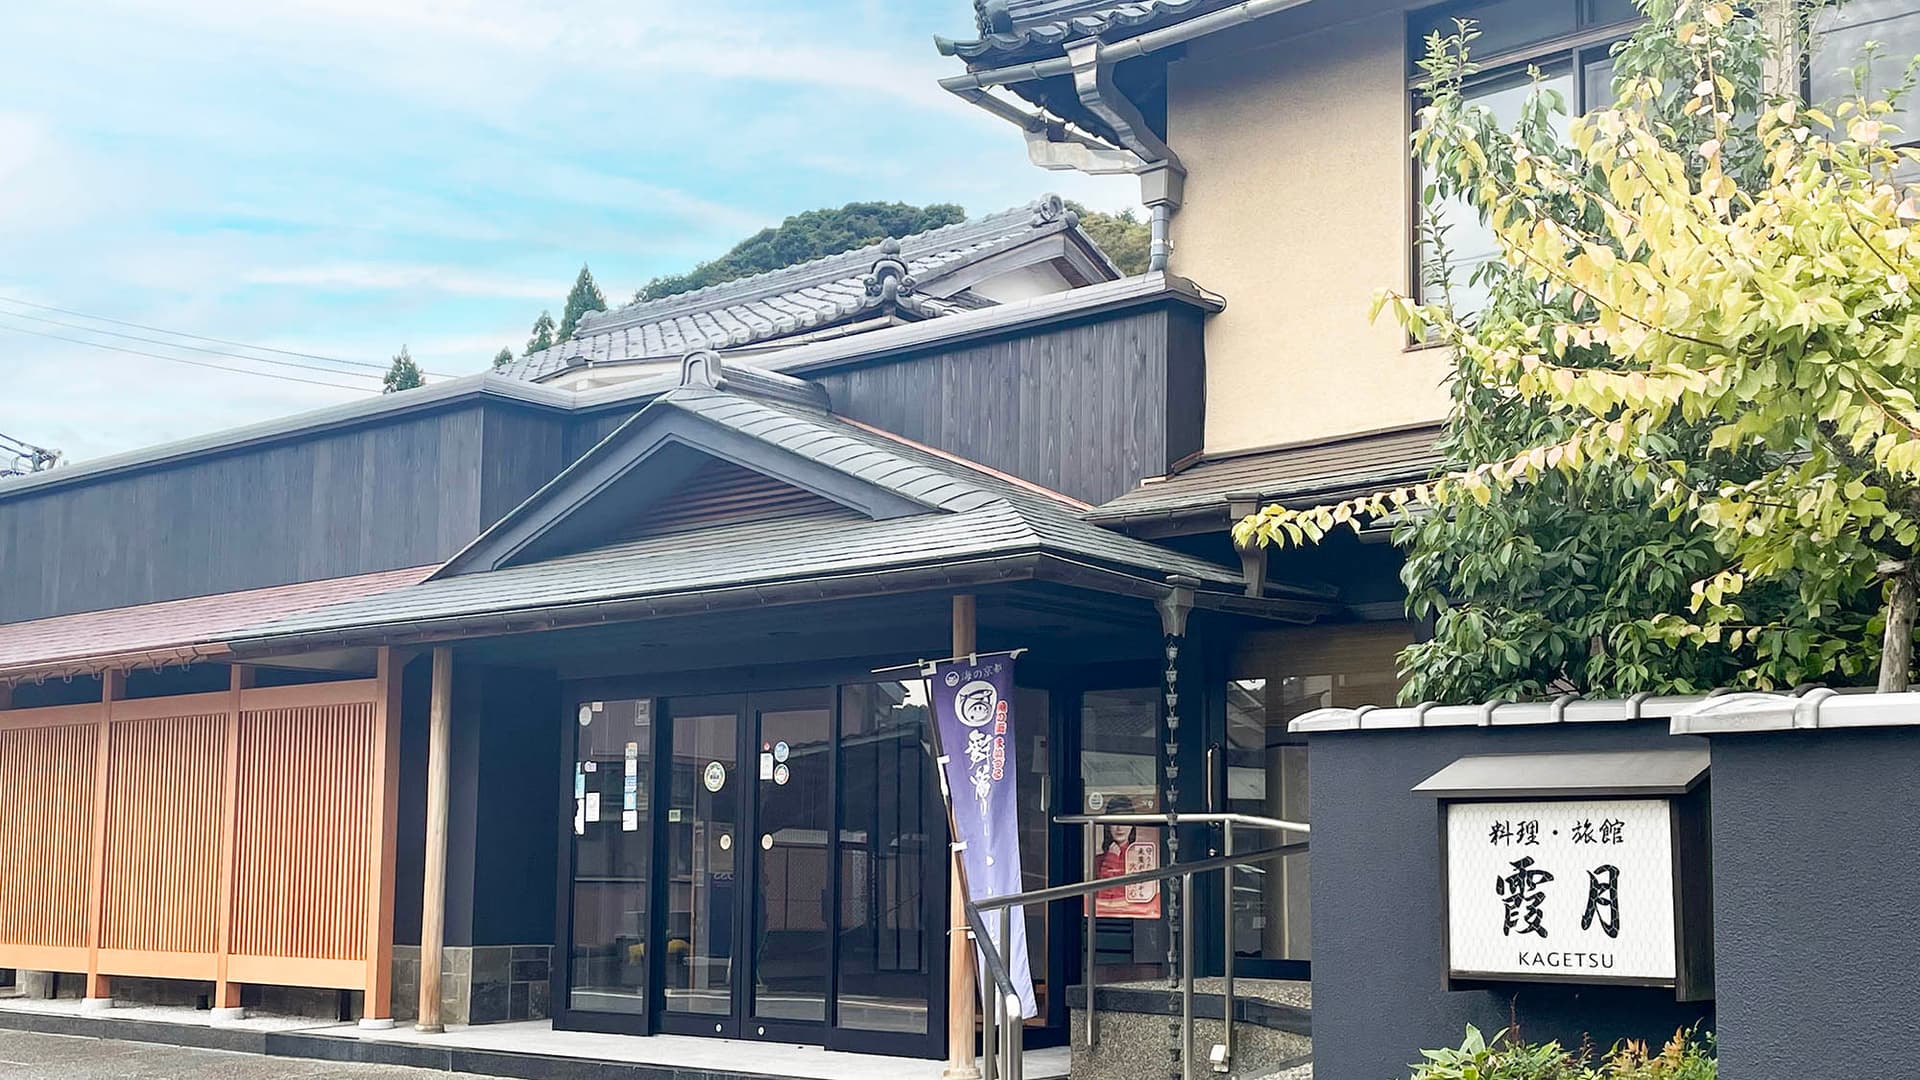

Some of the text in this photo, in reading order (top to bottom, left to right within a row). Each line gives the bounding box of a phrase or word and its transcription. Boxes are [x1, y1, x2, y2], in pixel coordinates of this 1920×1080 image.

[1489, 818, 1626, 846] 料理・旅館
[1495, 855, 1622, 939] 霞月
[1518, 951, 1615, 969] KAGETSU
